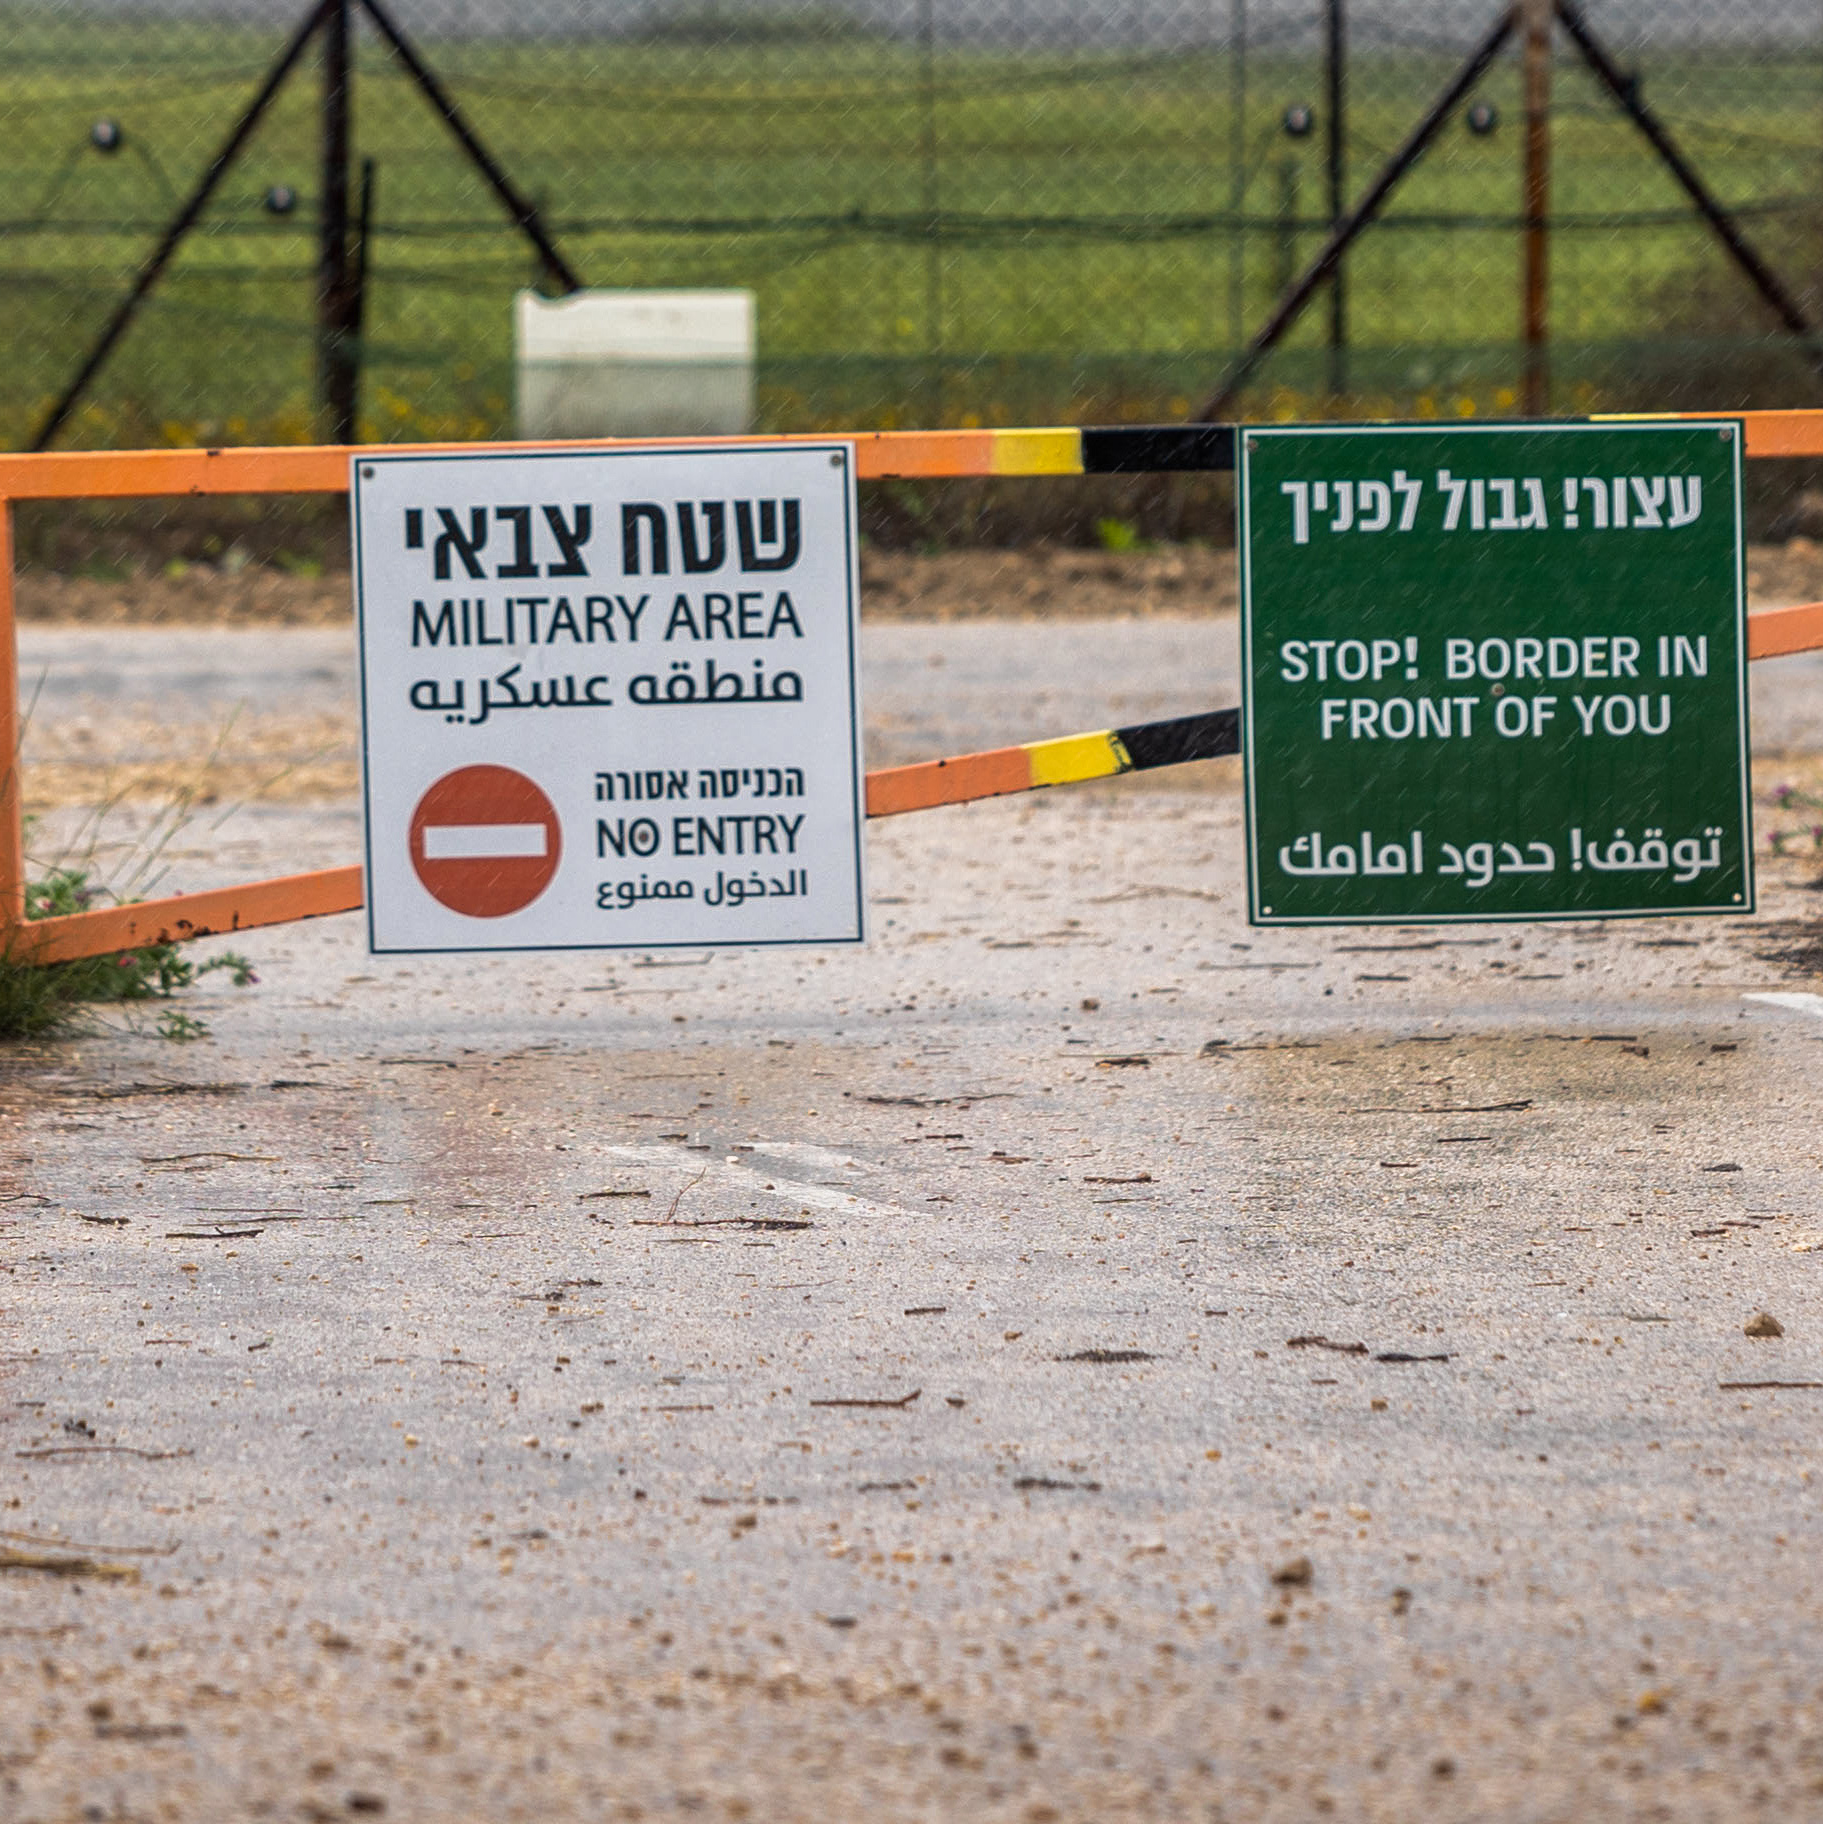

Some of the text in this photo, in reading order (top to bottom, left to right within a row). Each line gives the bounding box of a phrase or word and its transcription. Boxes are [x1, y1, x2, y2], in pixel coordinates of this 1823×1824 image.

[1281, 469, 1702, 543] עצור! גבול לפניך
[405, 498, 801, 580] שטח צבאי
[411, 591, 804, 647] MILITARY AREA
[1280, 635, 1708, 681] STOP! BORDER IN
[409, 659, 803, 724] منطقه عسكريه
[1321, 695, 1672, 739] FRONT OF YOU
[595, 768, 805, 801] הכניסה אסורה
[596, 814, 806, 858] NO ENTRY
[1279, 827, 1724, 887] توقف! حدود امامك
[596, 869, 808, 910] الدخول ممنوع
